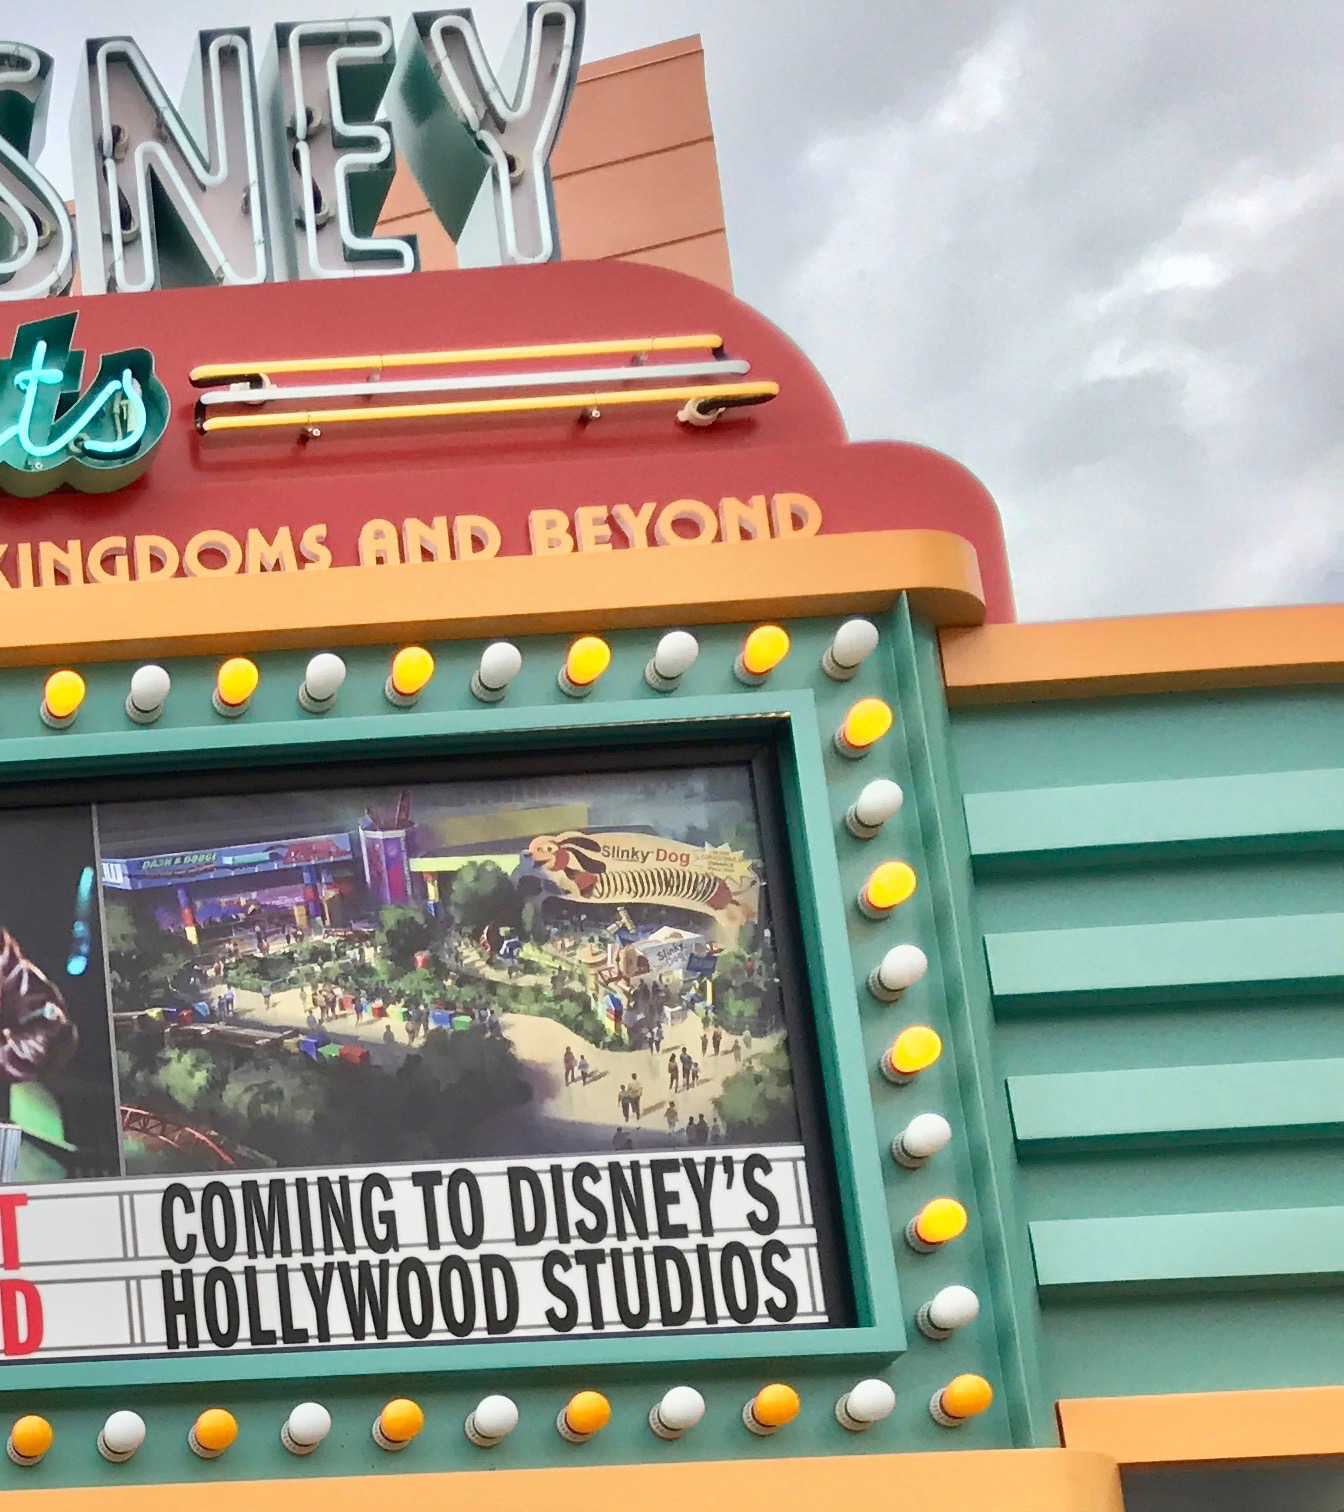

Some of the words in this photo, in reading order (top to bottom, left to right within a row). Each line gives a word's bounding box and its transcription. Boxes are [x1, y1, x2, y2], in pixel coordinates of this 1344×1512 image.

[358, 514, 502, 567] AND
[528, 491, 823, 557] BEYOND
[601, 844, 651, 864] Slinky
[655, 848, 691, 867] Dog
[160, 1171, 400, 1264] COMING
[412, 1166, 486, 1250] TO
[507, 1153, 780, 1248] DISNEY'S
[160, 1251, 521, 1351] HOLLYWOOD
[542, 1239, 799, 1334] STUDIOS
